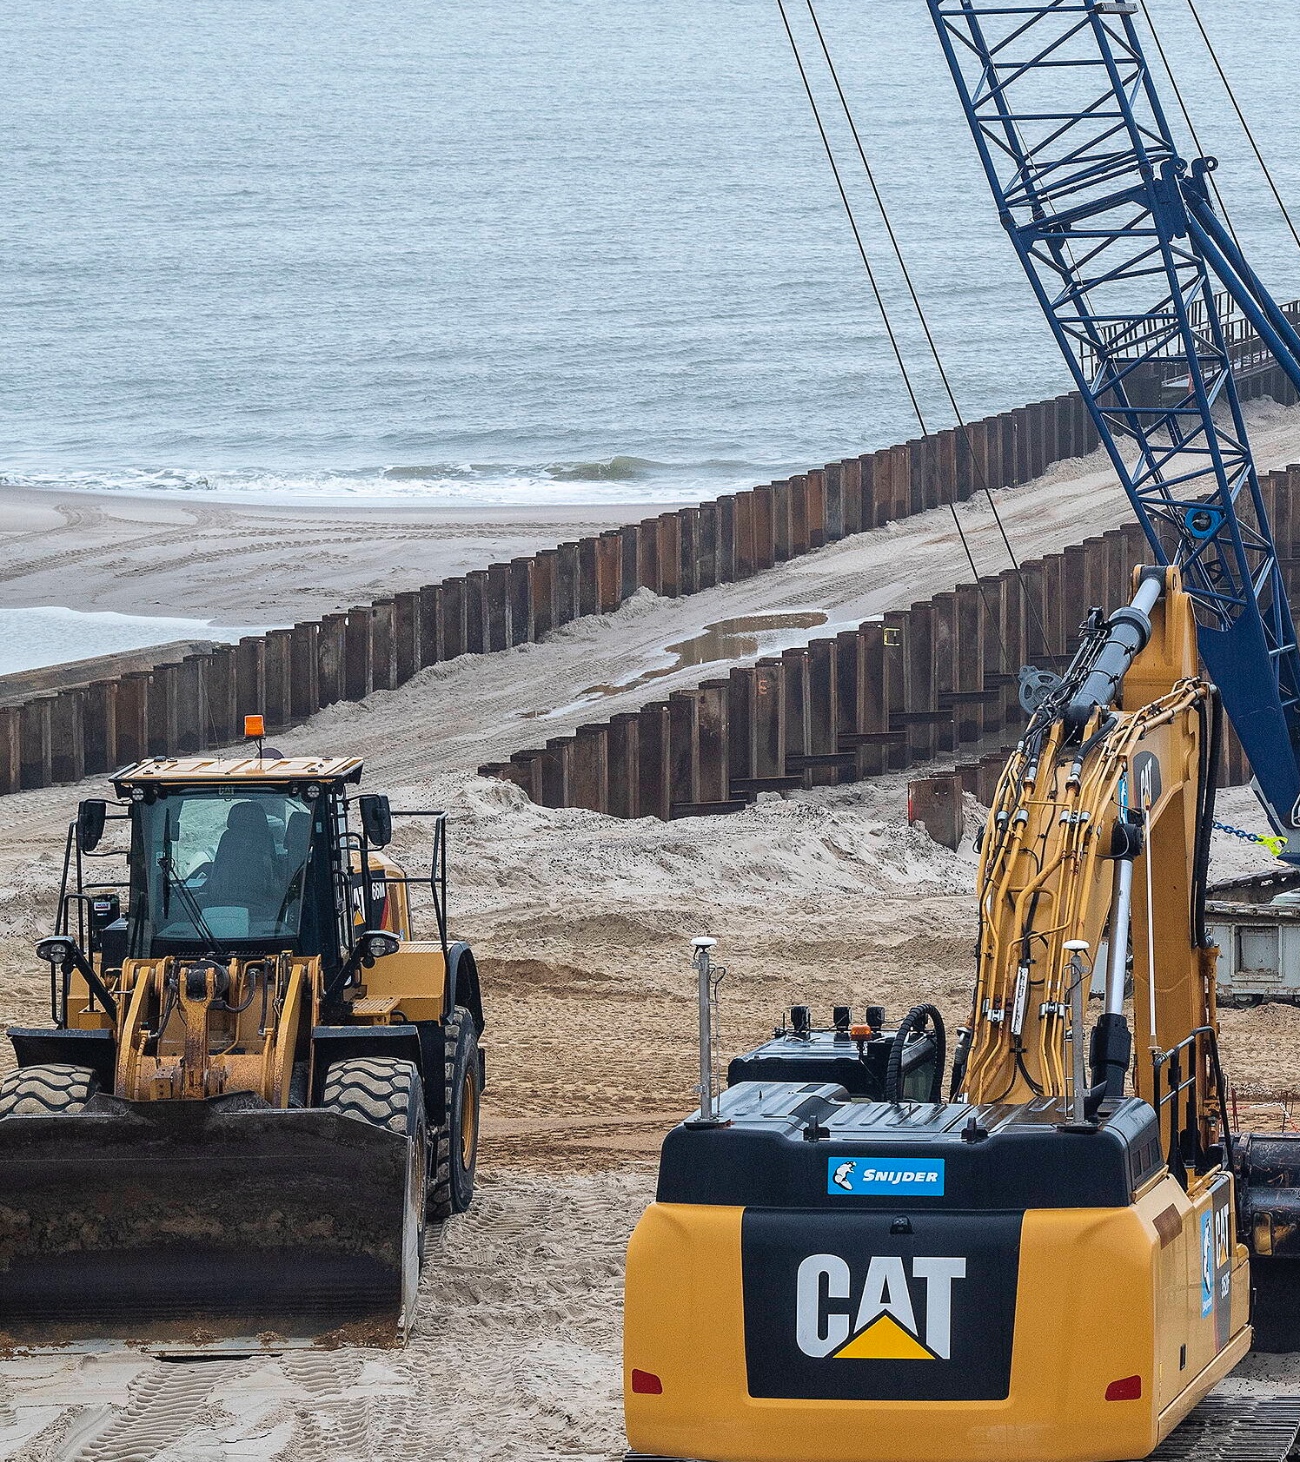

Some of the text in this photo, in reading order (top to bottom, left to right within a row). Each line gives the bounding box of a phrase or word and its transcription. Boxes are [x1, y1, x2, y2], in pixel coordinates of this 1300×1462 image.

[862, 1169, 939, 1185] SNIJDER
[1215, 1203, 1230, 1269] CAT
[796, 1253, 967, 1360] CAT
